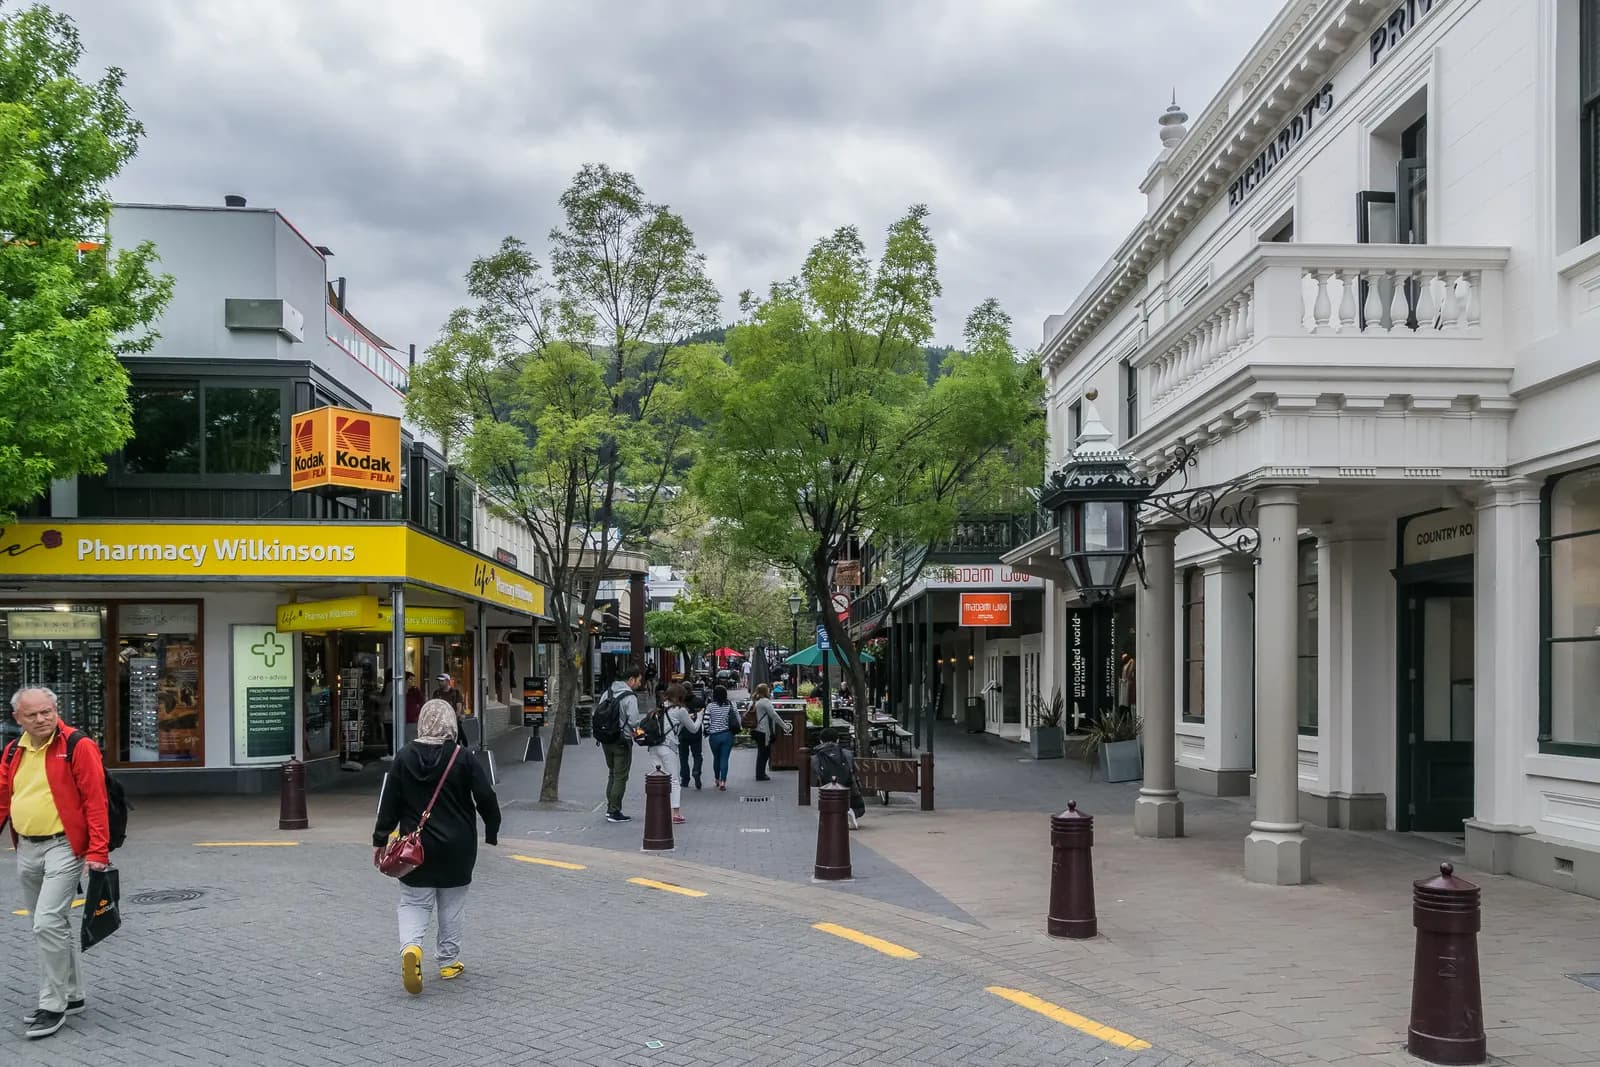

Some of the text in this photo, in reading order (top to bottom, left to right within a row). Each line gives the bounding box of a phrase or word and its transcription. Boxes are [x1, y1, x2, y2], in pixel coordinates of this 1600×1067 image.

[1229, 83, 1333, 211] EICHARDT'S
[295, 451, 324, 472] Kodak
[336, 450, 391, 472] Kodak
[312, 467, 326, 478] FILM
[370, 472, 394, 483] FILM
[1416, 523, 1474, 545] COUNTRY RO
[77, 538, 355, 567] Pharmacy Wilkinsons
[474, 563, 492, 595] life
[1072, 648, 1081, 697] untouched
